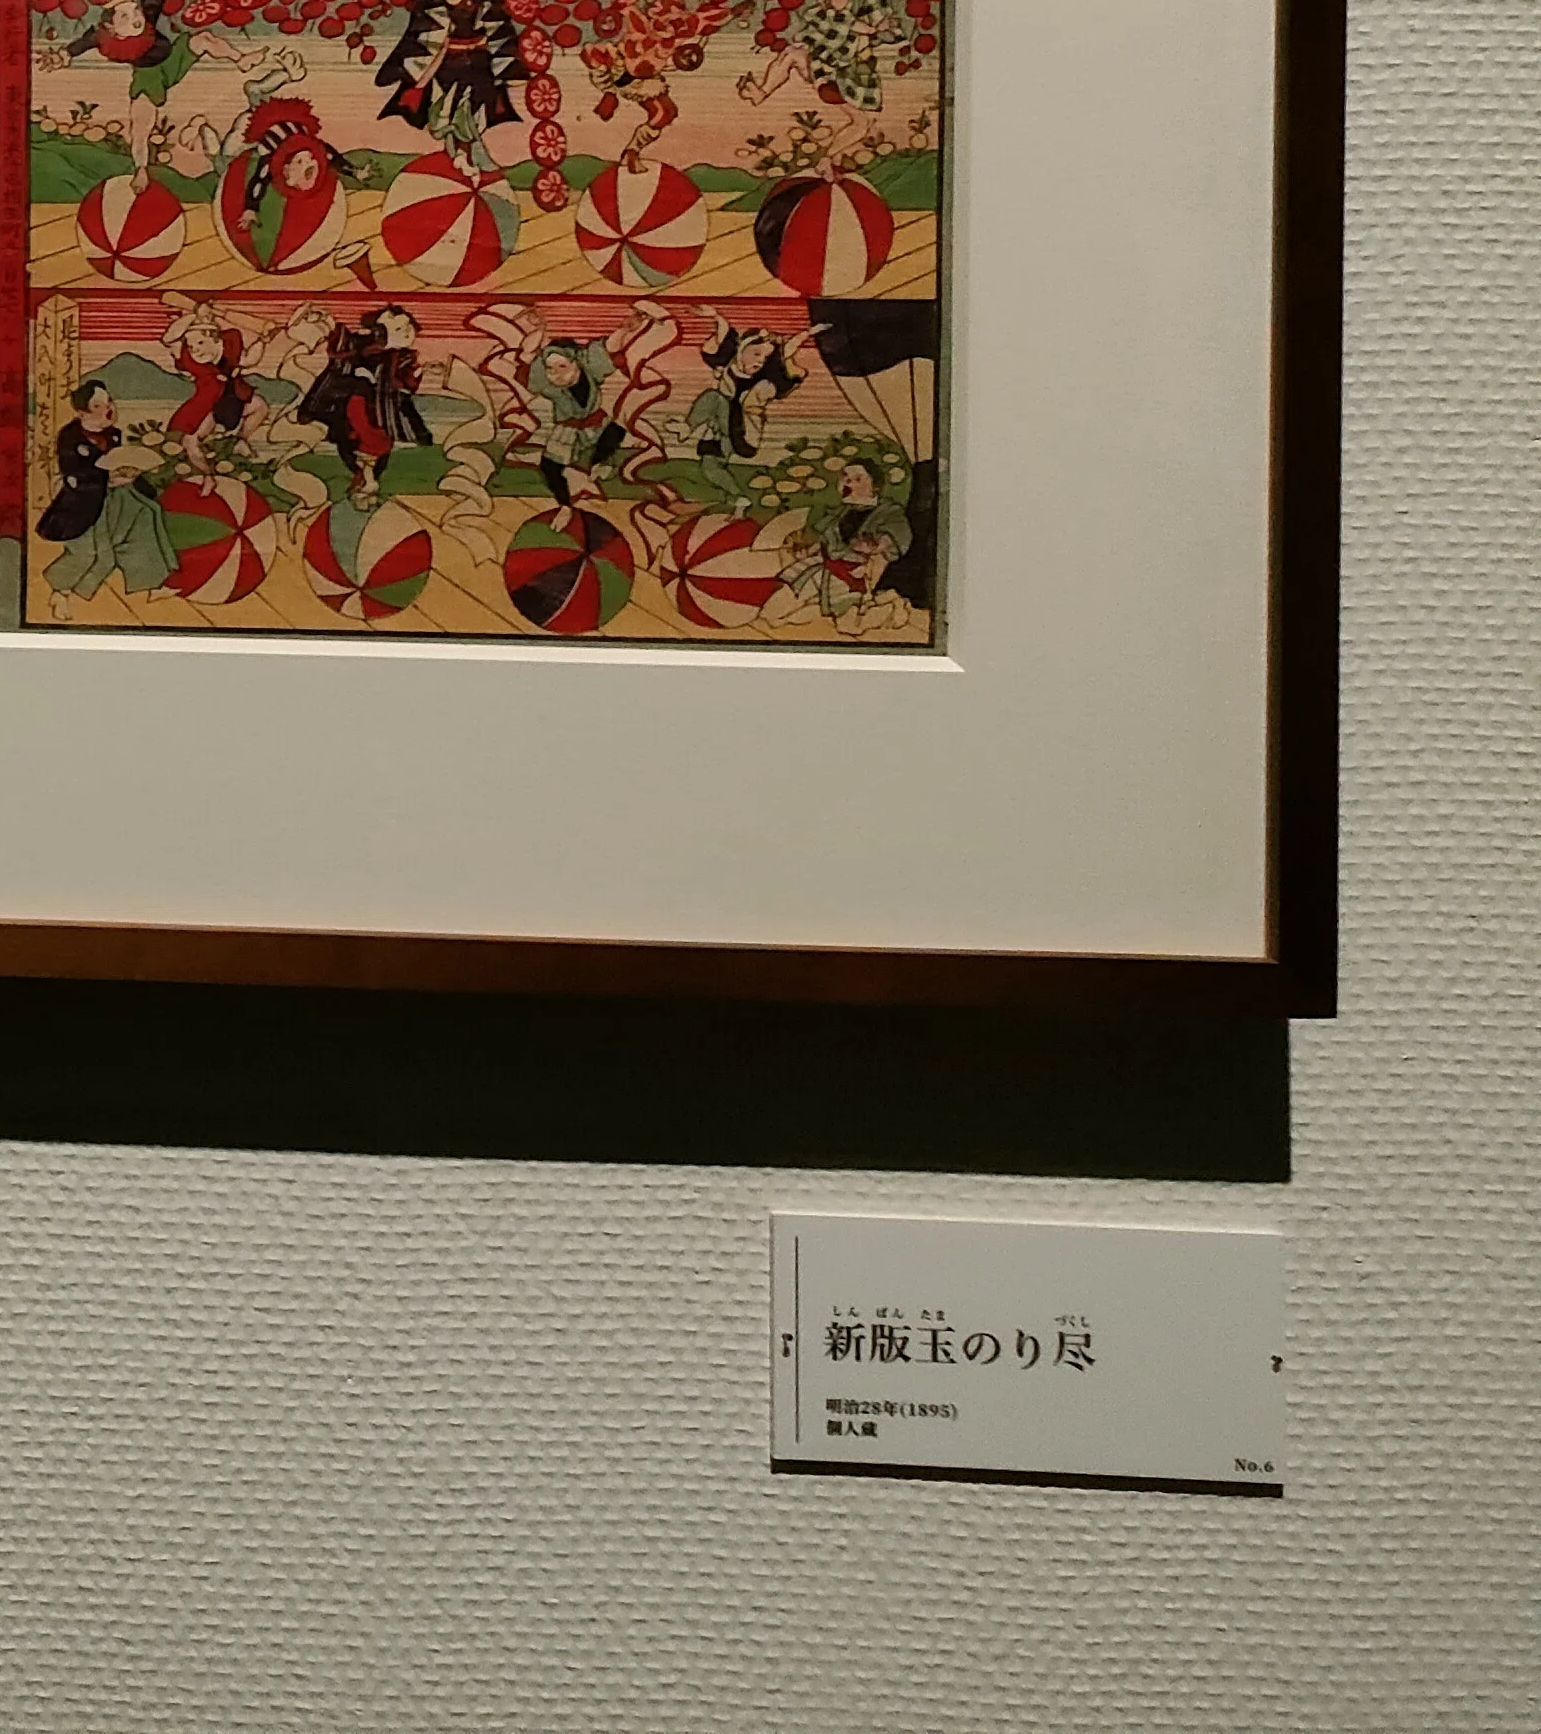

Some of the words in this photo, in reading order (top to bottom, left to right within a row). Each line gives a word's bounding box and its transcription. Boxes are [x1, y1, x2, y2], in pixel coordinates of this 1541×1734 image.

[823, 1320, 1097, 1373] 新版玉のり尽
[825, 1398, 958, 1421] 明治28年(1895)
[826, 1419, 878, 1439] 個人蔵
[1234, 1457, 1275, 1474] No.6
